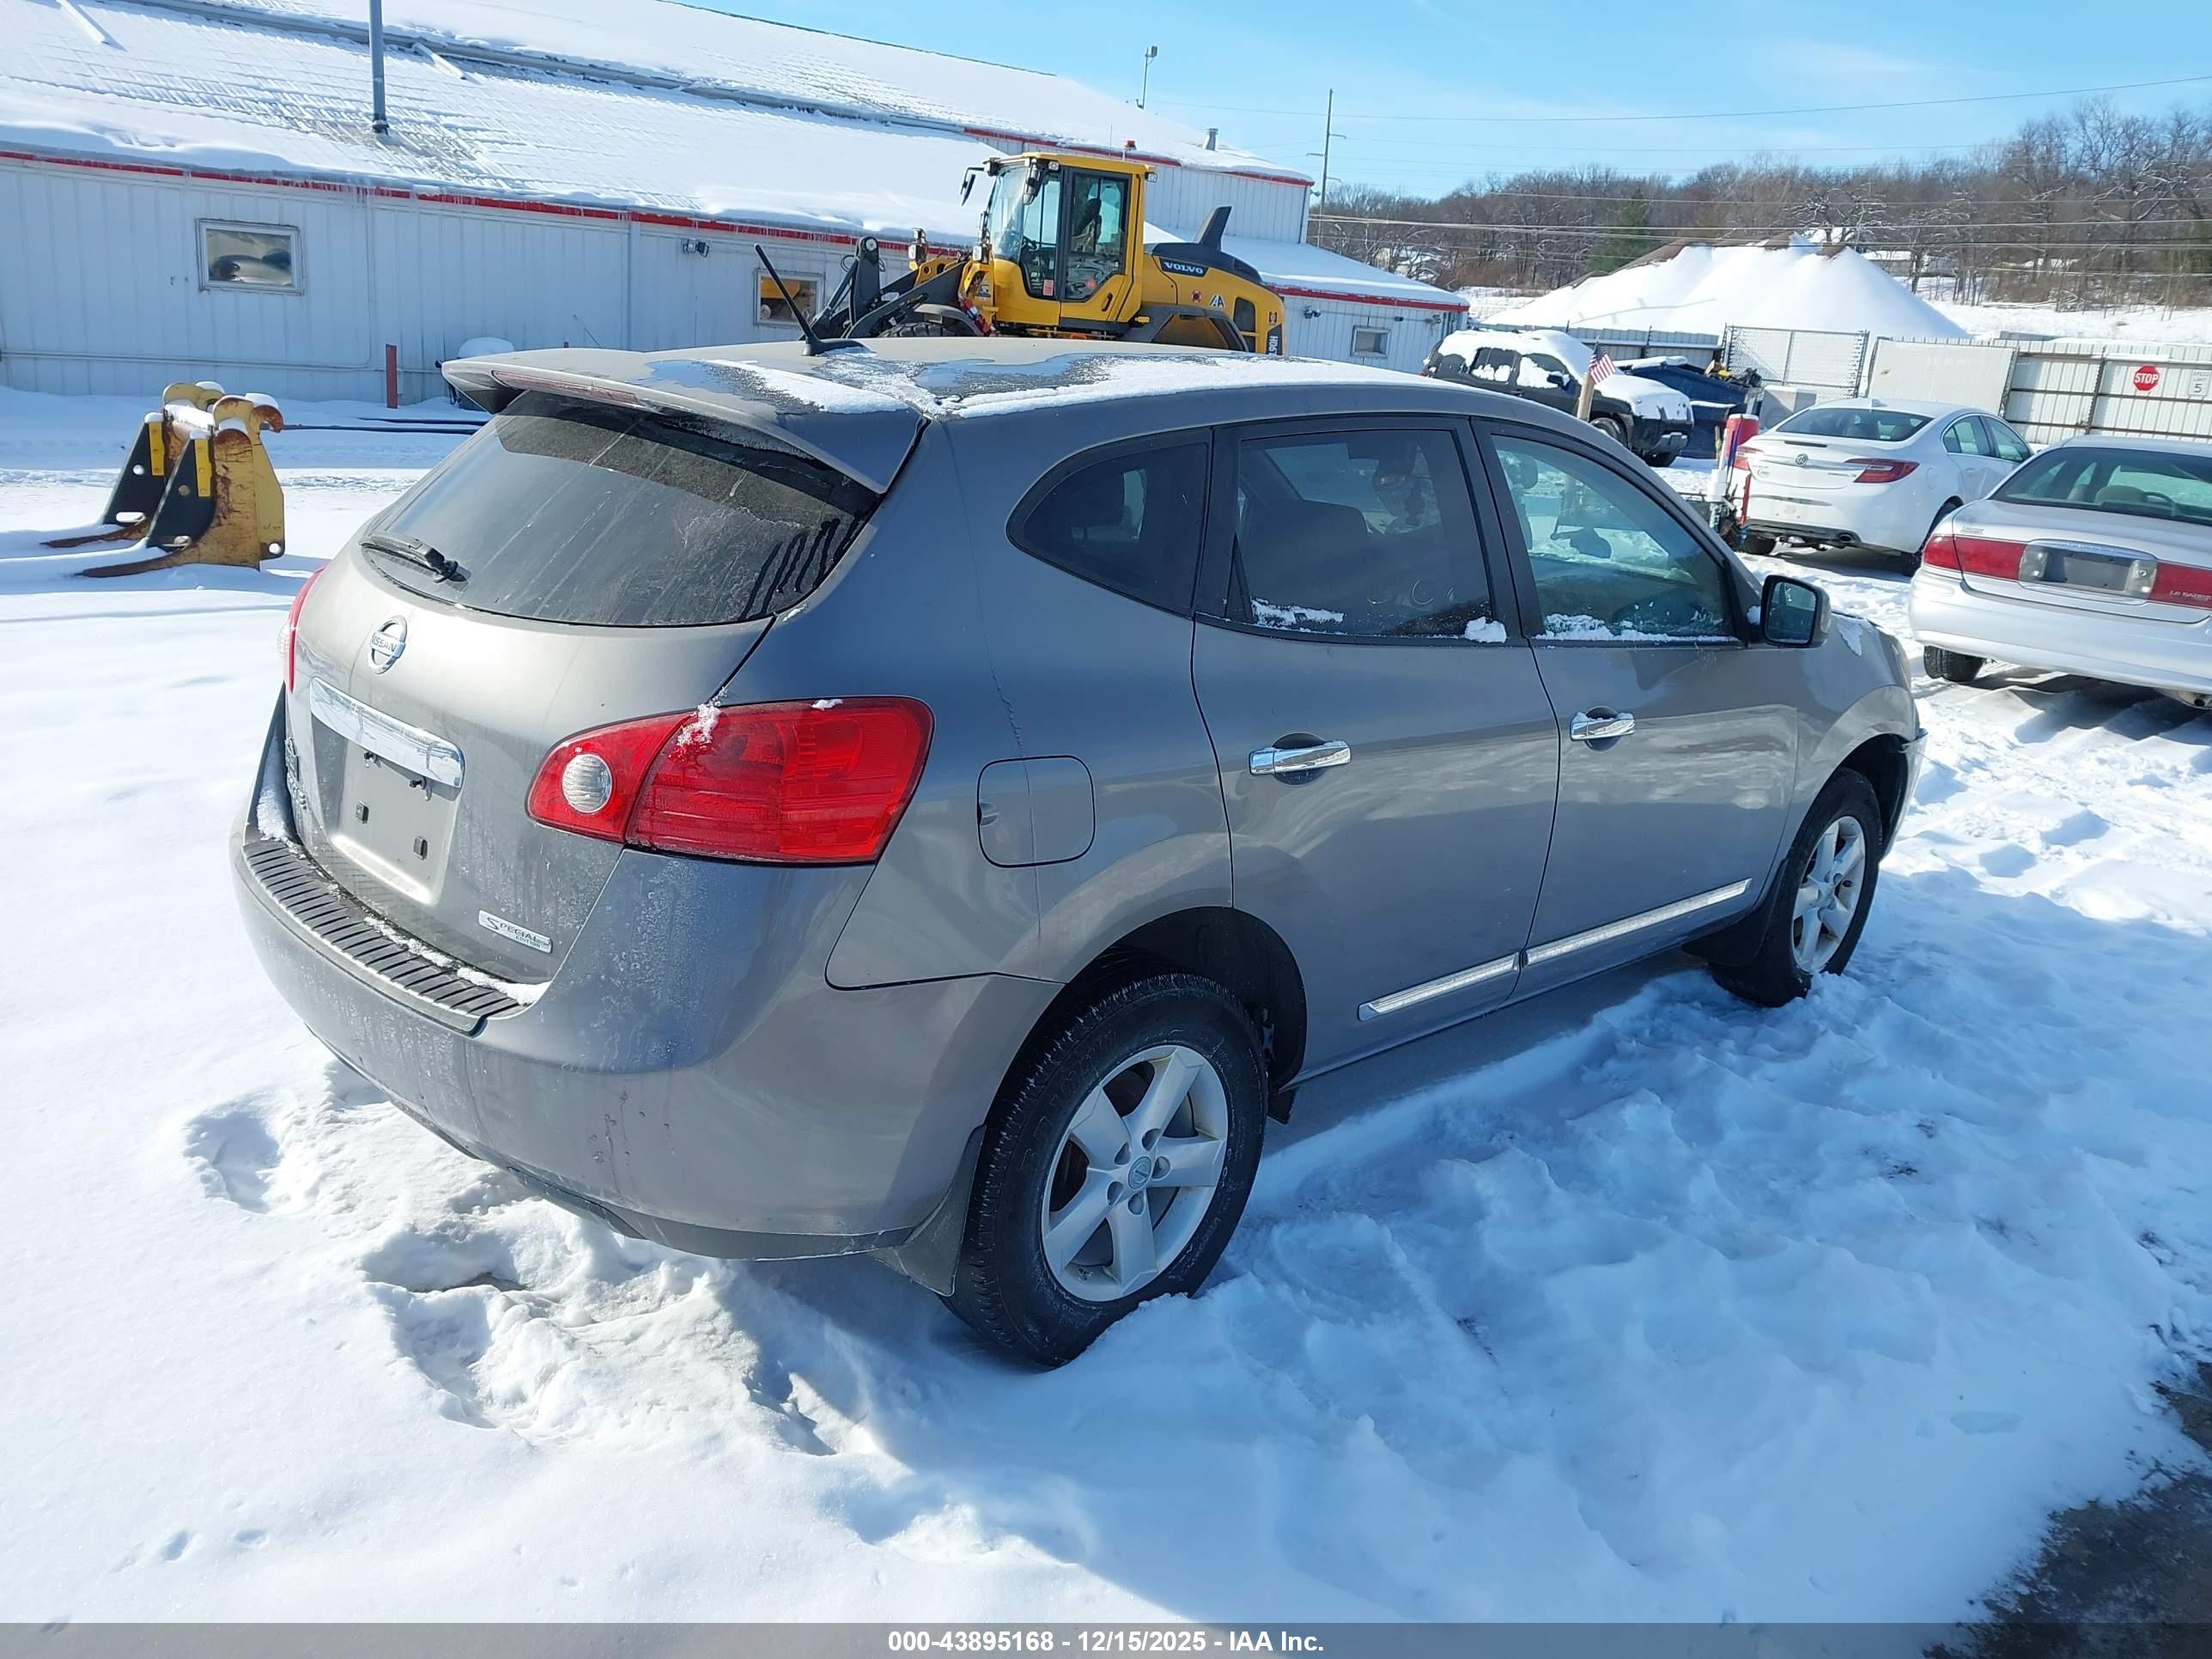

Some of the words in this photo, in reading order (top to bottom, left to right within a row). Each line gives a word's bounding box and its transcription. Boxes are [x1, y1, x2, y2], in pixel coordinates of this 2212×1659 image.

[1163, 261, 1204, 274] VOLVO
[2134, 373, 2159, 385] STOP
[2194, 383, 2203, 392] 5
[371, 635, 398, 653] NISSAN
[487, 916, 539, 941] SPECIAL
